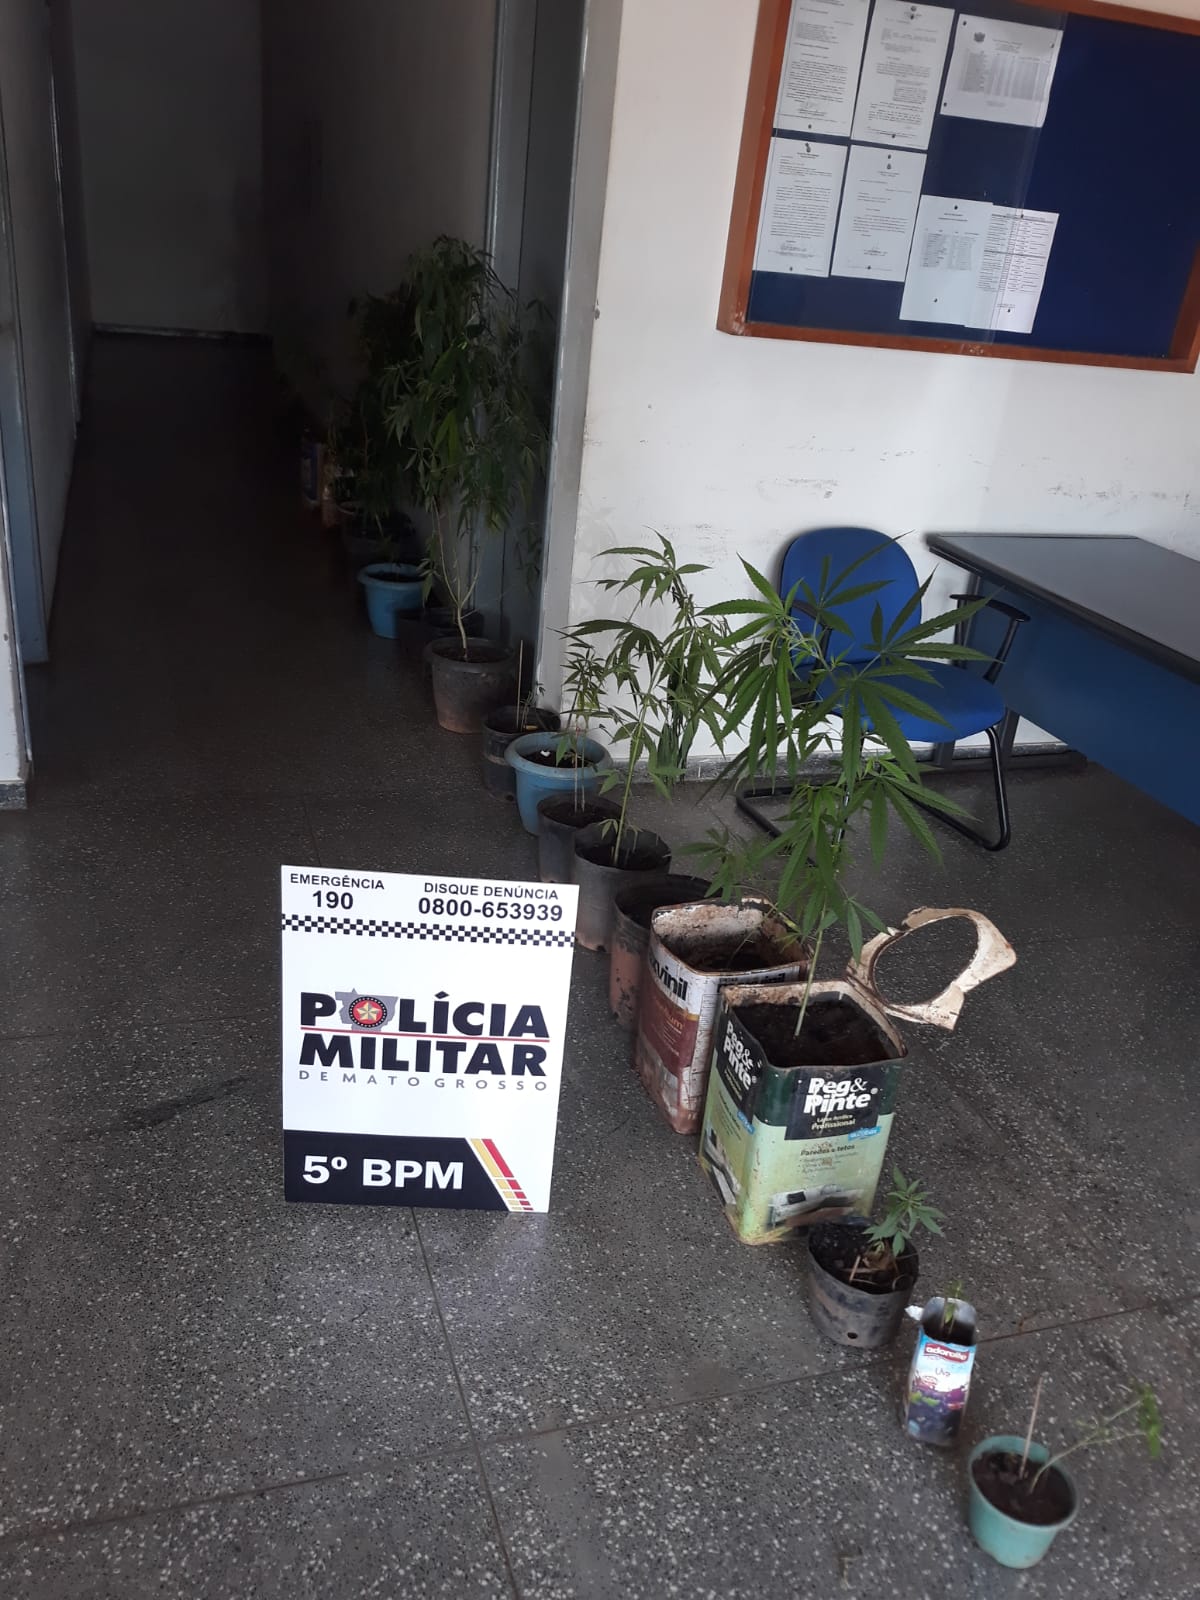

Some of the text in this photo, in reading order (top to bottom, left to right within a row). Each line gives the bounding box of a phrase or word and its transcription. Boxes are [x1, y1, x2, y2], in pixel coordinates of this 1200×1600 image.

[290, 873, 385, 890] EMERGÊNCIA
[424, 882, 559, 900] DISQUE DENÚNCIA
[312, 890, 354, 910] 190
[418, 897, 563, 922] 0800-653939
[299, 1033, 548, 1077] MILITAR
[299, 1070, 547, 1091] DE MATO GROSSO
[808, 1077, 868, 1097] Peg&
[803, 1092, 872, 1115] Pinte
[362, 1158, 464, 1190] BPM
